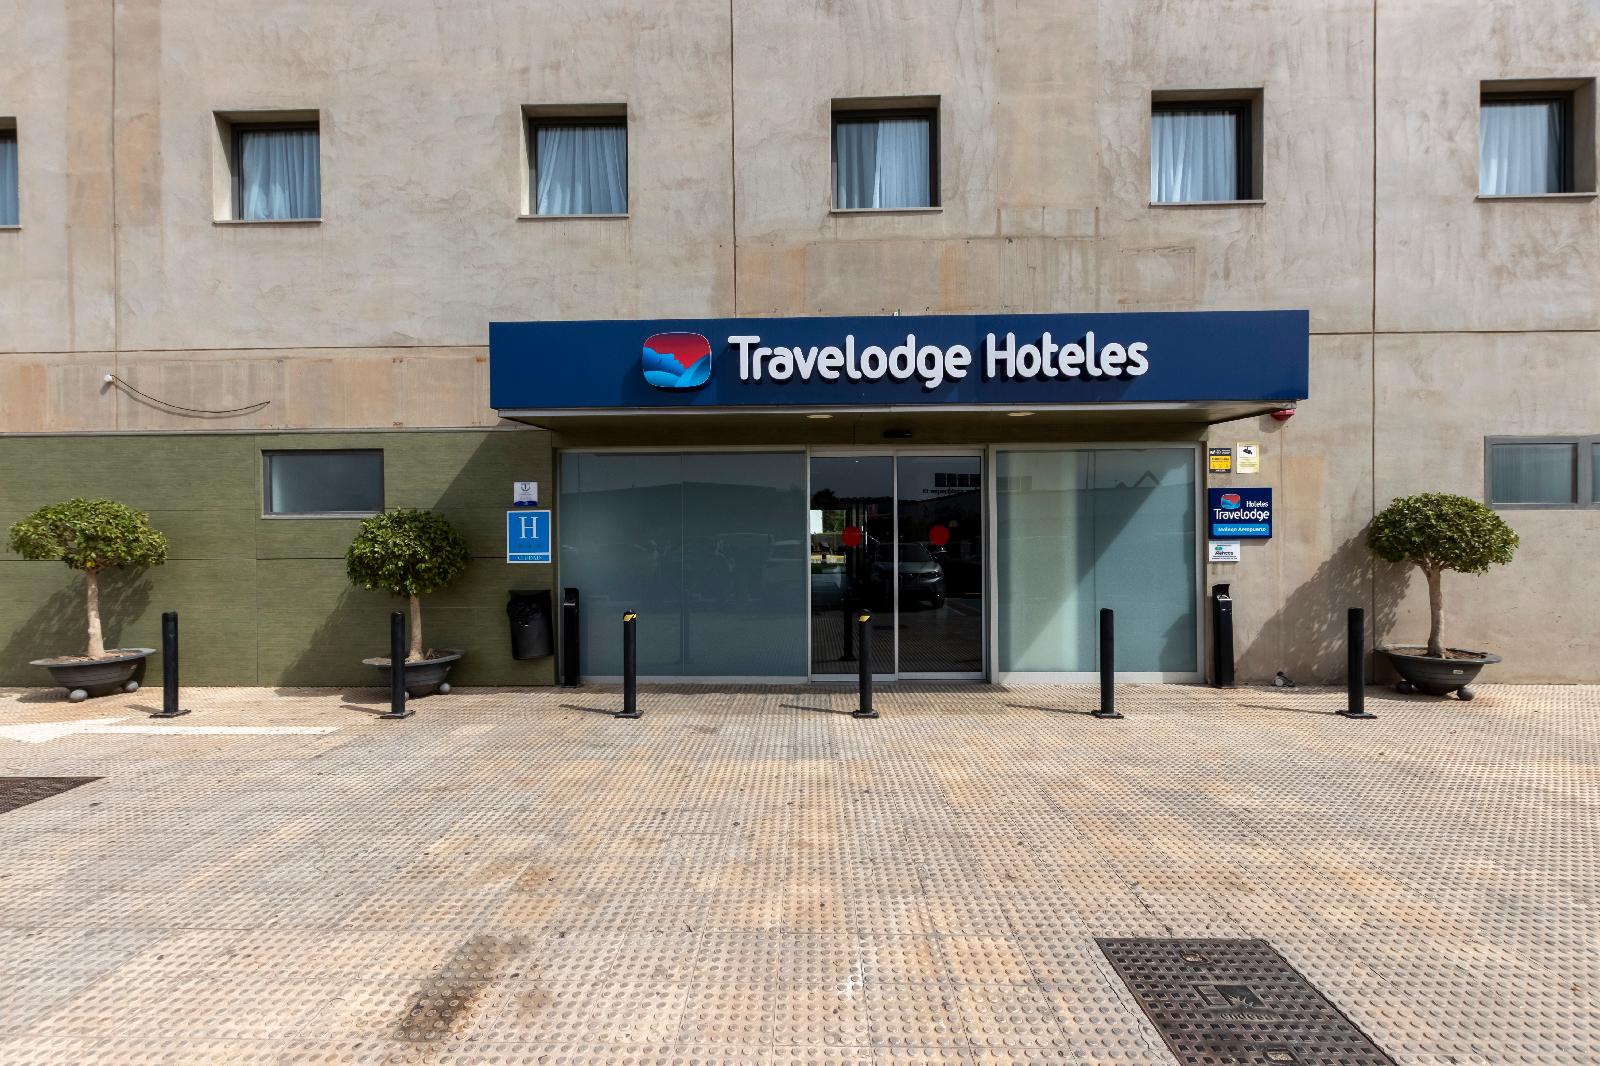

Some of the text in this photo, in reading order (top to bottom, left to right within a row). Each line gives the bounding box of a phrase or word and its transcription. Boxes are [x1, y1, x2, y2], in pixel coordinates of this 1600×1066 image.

[727, 330, 1149, 390] Travelodge Hoteles
[1246, 500, 1269, 509] Hoteles
[1213, 508, 1270, 522] Travelodge
[518, 516, 540, 540] H
